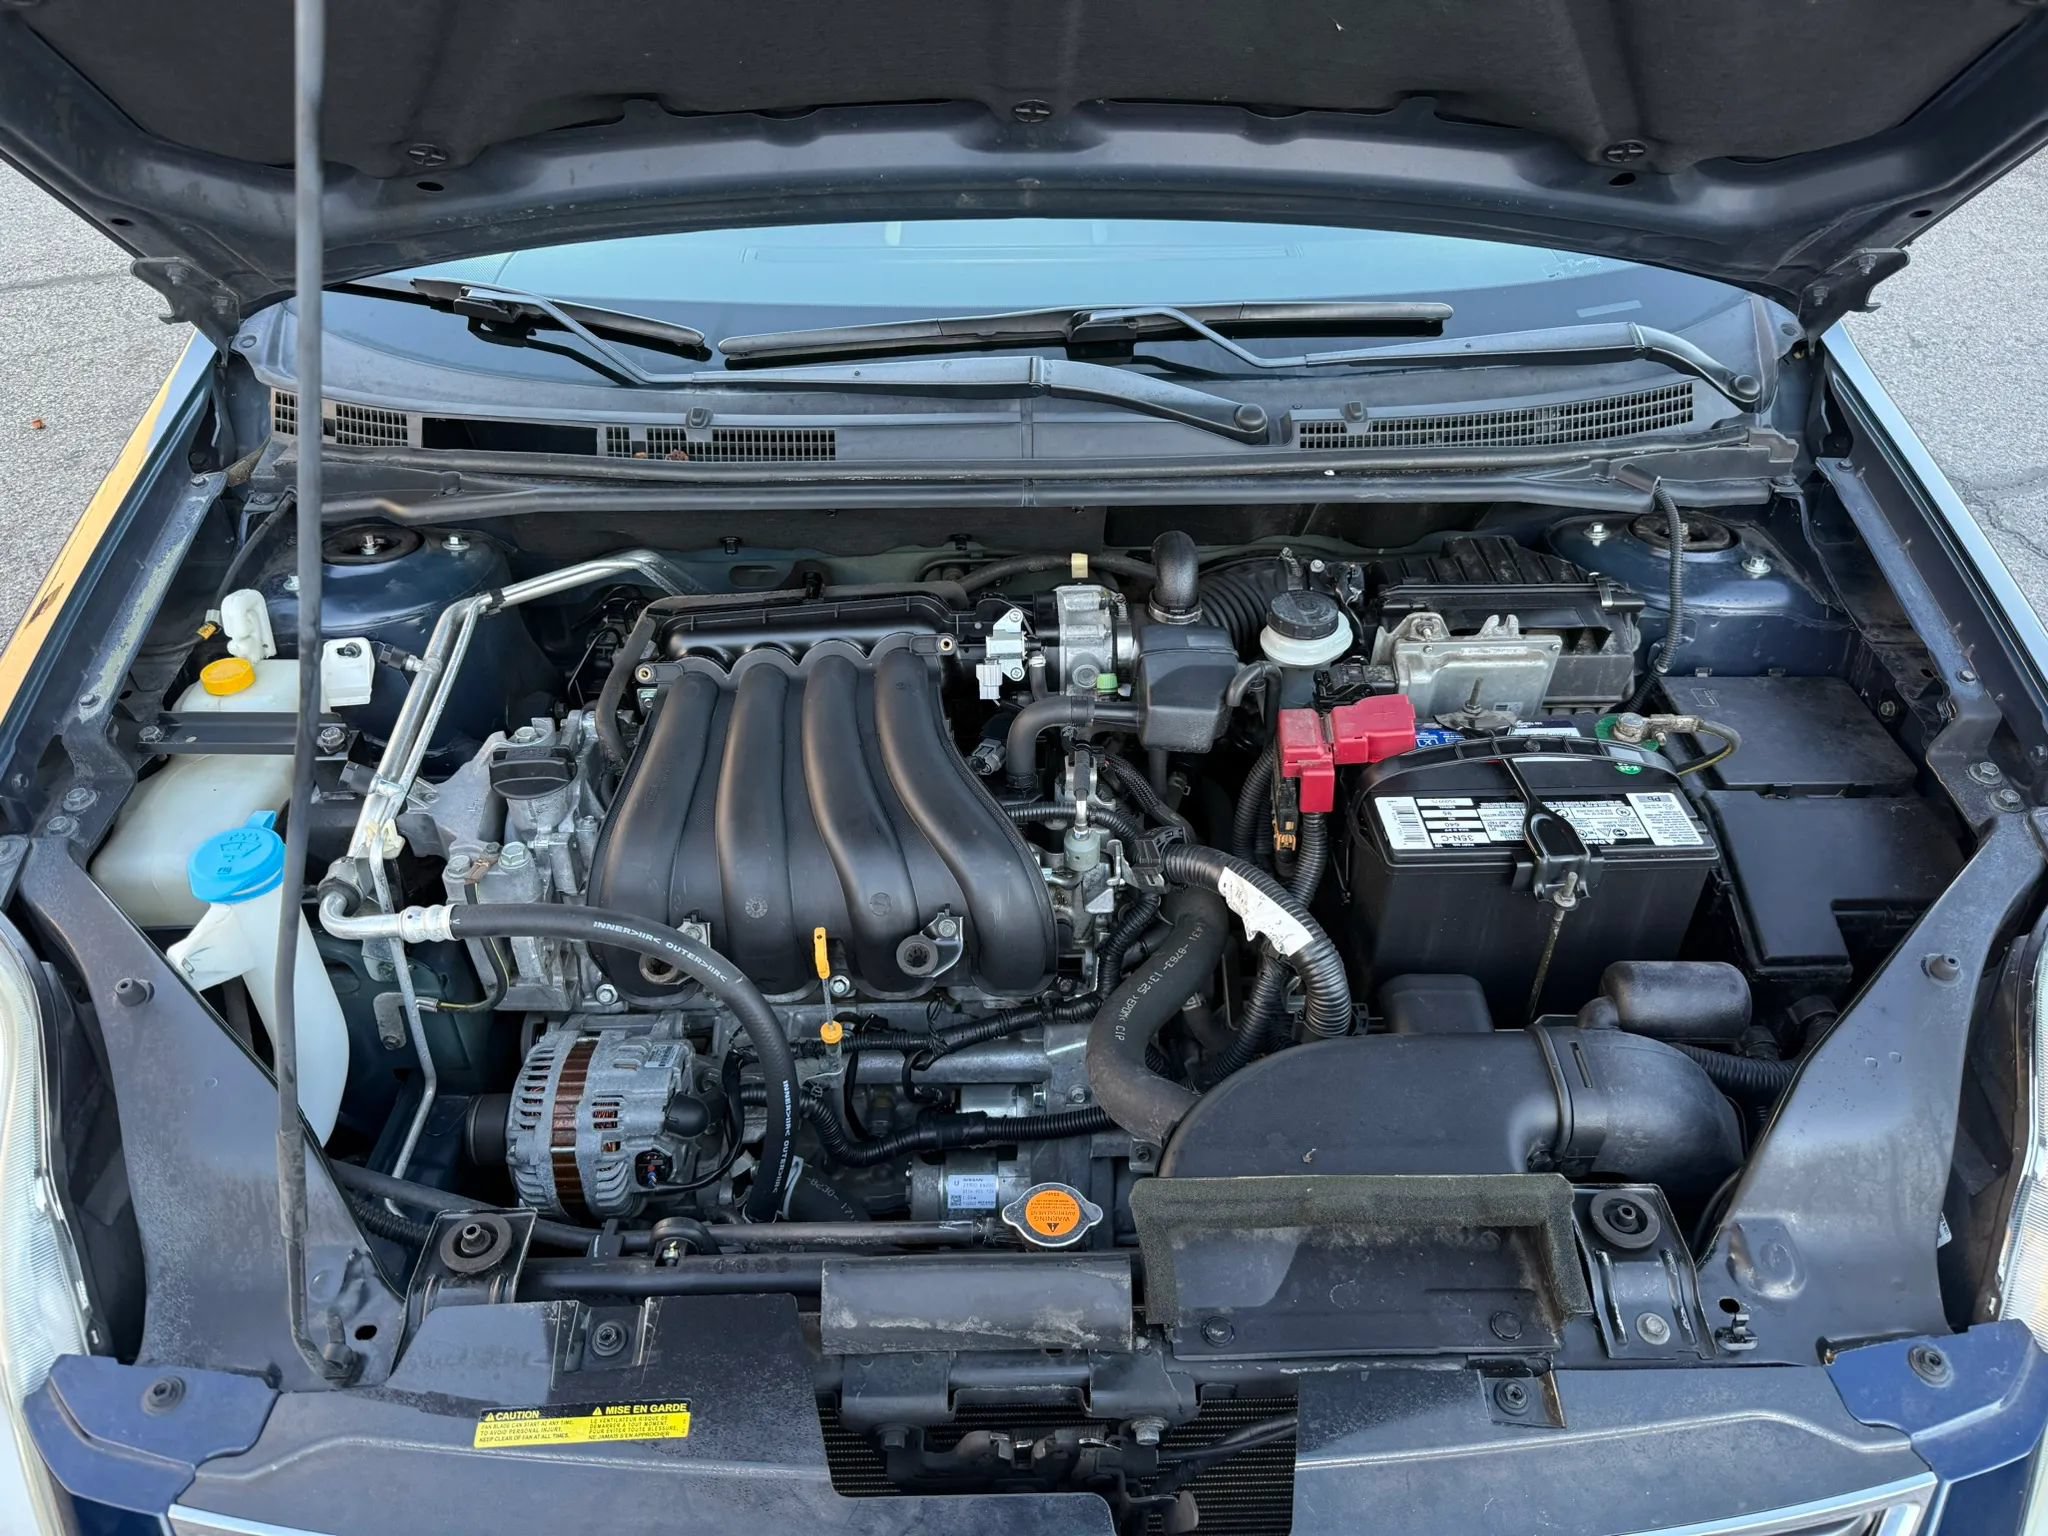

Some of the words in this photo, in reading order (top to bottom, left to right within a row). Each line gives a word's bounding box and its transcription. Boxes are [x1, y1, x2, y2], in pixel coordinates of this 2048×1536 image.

[1440, 834, 1475, 842] 35N-C
[605, 1405, 631, 1415] MISE
[633, 1404, 648, 1414] EN
[649, 1403, 688, 1413] GARDE
[495, 1410, 540, 1421] CAUTION
